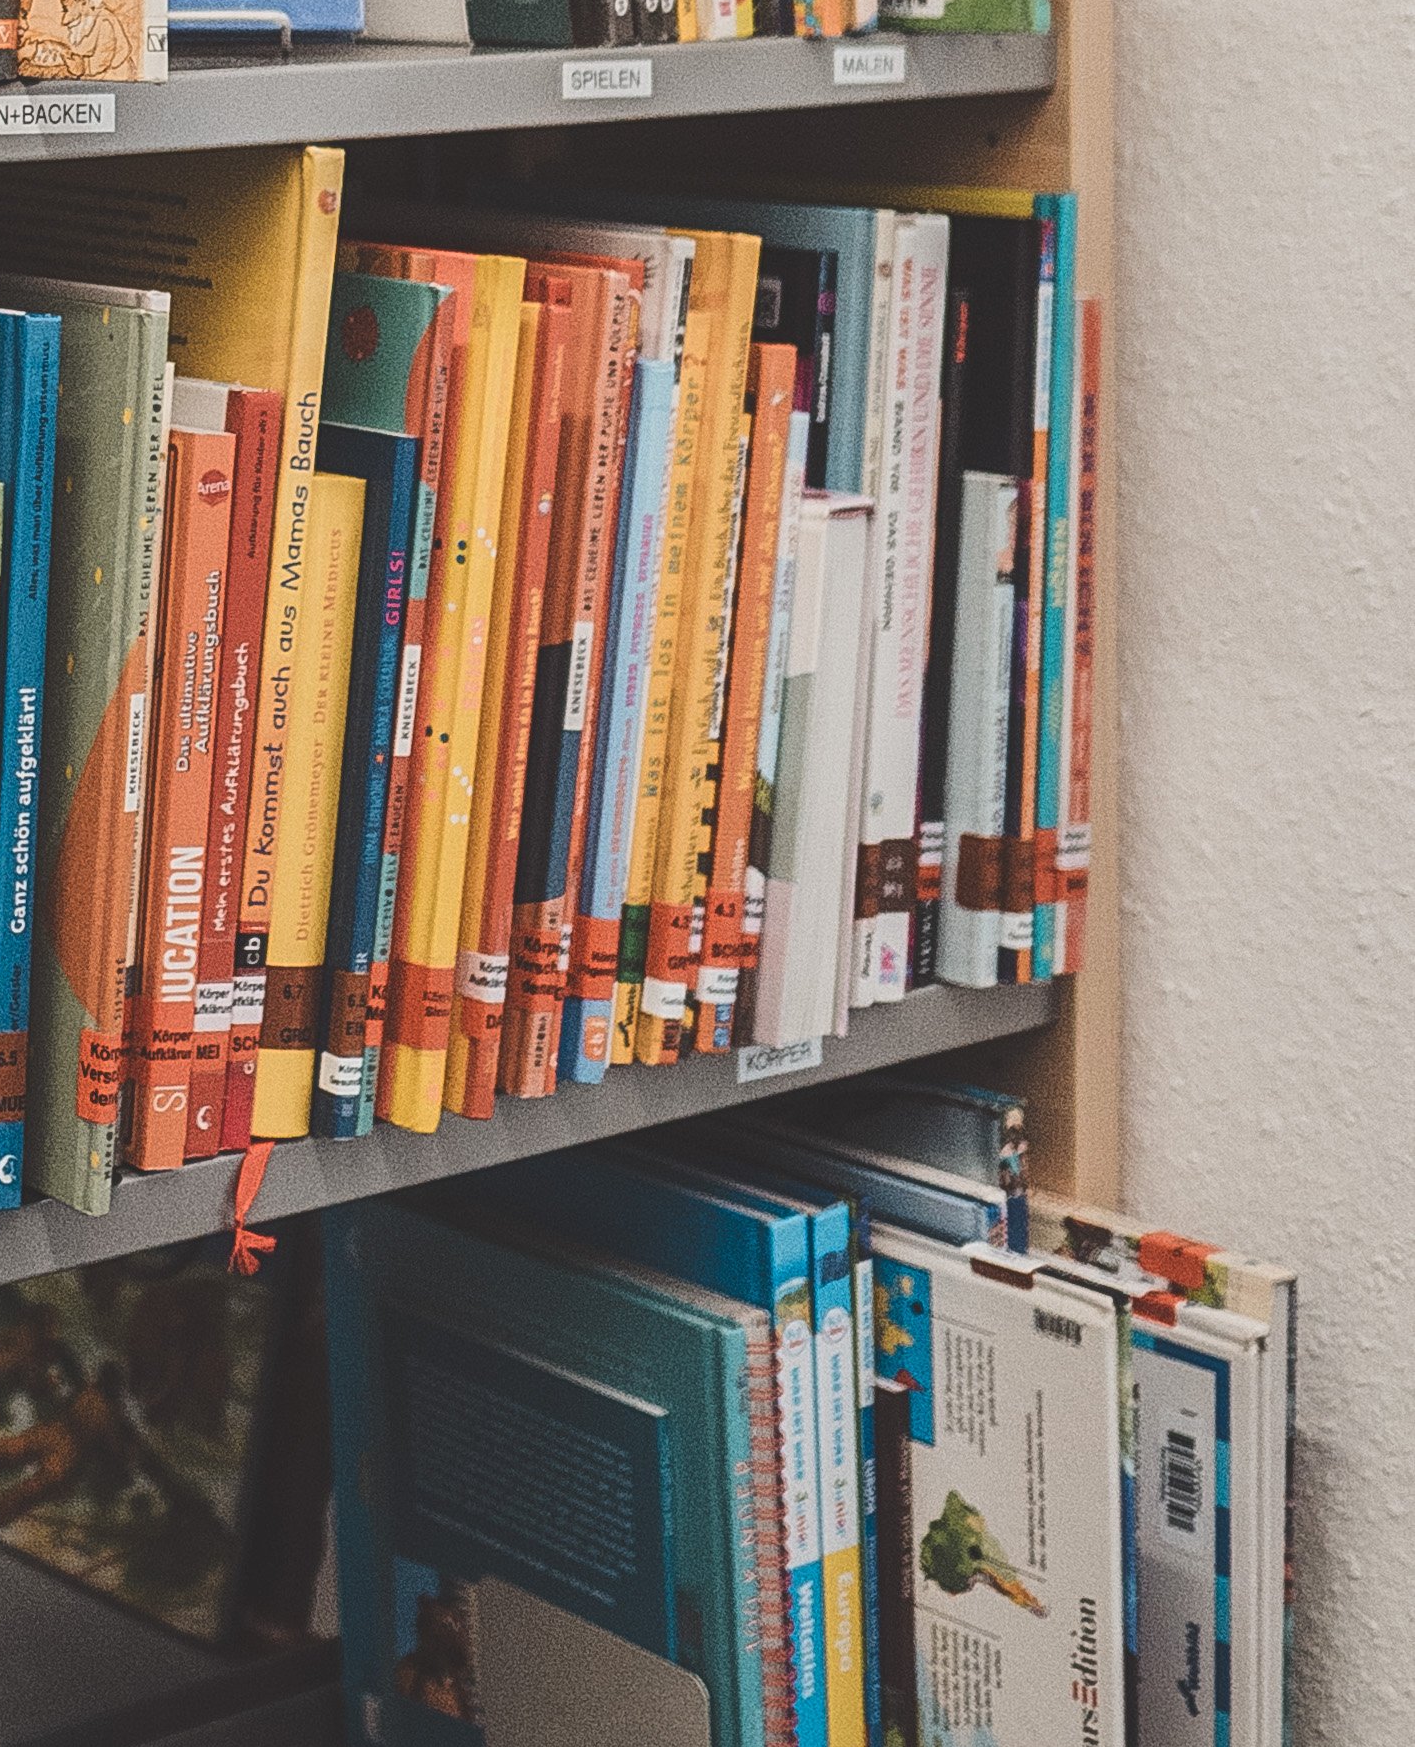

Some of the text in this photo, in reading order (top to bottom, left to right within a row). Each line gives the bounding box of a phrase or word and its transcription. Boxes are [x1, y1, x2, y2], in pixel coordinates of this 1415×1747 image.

[570, 68, 642, 90] SPIELEN
[842, 55, 894, 76] MALEN
[273, 391, 318, 730] auch aus Mamas Bauch
[385, 549, 404, 626] GIRLS!
[195, 570, 221, 754] Aufklärungsbuch
[401, 660, 417, 740] KNESEBECK
[128, 710, 141, 795] KNESEBECK
[11, 812, 30, 934] Ganz schön
[744, 1040, 811, 1073] KÖRPER
